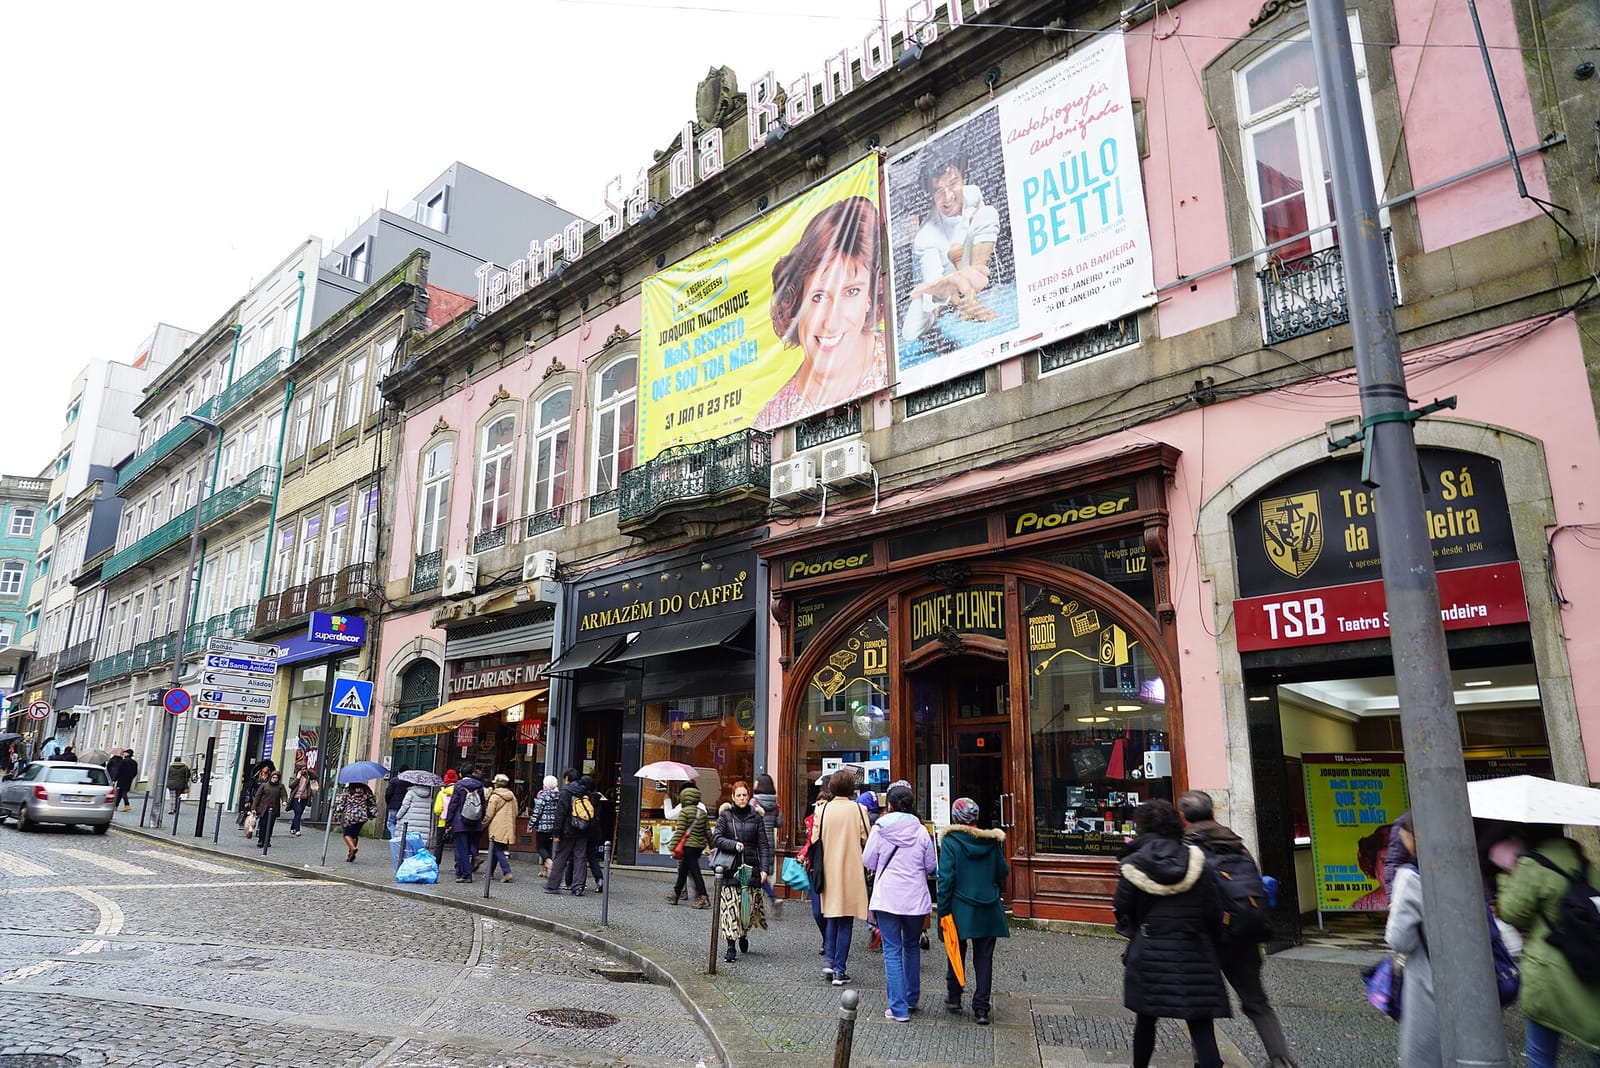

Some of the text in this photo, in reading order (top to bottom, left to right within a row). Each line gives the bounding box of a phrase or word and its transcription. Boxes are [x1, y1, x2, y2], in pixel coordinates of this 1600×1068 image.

[1022, 137, 1119, 215] PAULO
[475, 218, 584, 317] Teatro
[600, 166, 648, 243] Sá
[670, 120, 724, 199] da
[1027, 175, 1124, 256] BETTI
[1027, 239, 1136, 293] TEATRO SÁ DA BANDEIRA
[702, 276, 723, 297] SUCESSO
[1042, 294, 1047, 302] E
[1059, 285, 1069, 296] DE
[1071, 272, 1103, 291] JANEIRO
[1056, 298, 1066, 310] DE
[1068, 285, 1100, 306] JANEIRO
[658, 289, 750, 346] JOAQUIM MONCHIQUE
[692, 317, 745, 358] RESPEITO
[651, 376, 672, 402] QUE
[675, 366, 699, 393] SOU
[702, 355, 726, 383] TUA
[729, 338, 758, 372] MÃE!
[665, 412, 674, 430] 31
[677, 405, 695, 426] JAN
[697, 402, 704, 419] A
[707, 396, 721, 416] 23
[1440, 466, 1474, 501] Sá
[1015, 496, 1130, 535] Pioneer
[1344, 523, 1369, 553] da
[1441, 544, 1463, 557] desde
[1466, 541, 1484, 553] 1856
[1129, 545, 1146, 558] para
[788, 552, 868, 579] Pioneer
[1125, 556, 1147, 574] LUZ
[579, 599, 655, 632] ARMAZÉM
[658, 594, 683, 616] DO
[797, 613, 814, 628] SOM
[913, 590, 1004, 641] DANCE PLANET
[1028, 613, 1056, 625] PRODUÇÃO
[1262, 597, 1327, 640] TSB
[1337, 616, 1380, 633] Teatro
[1440, 603, 1488, 622] ndeira
[314, 631, 361, 643] superdecor
[1029, 622, 1056, 645] ÁUDIO
[211, 643, 233, 651] Bolhão
[863, 646, 888, 670] DJ
[228, 662, 274, 673] Santo António
[247, 680, 272, 688] Aliados
[448, 668, 513, 694] CUTELARIAS
[250, 696, 266, 704] João
[1320, 767, 1391, 778] JOAQUIM MONCHIQUE
[1335, 790, 1381, 807] QUE SOU
[1334, 806, 1387, 825] TUA MÃE!
